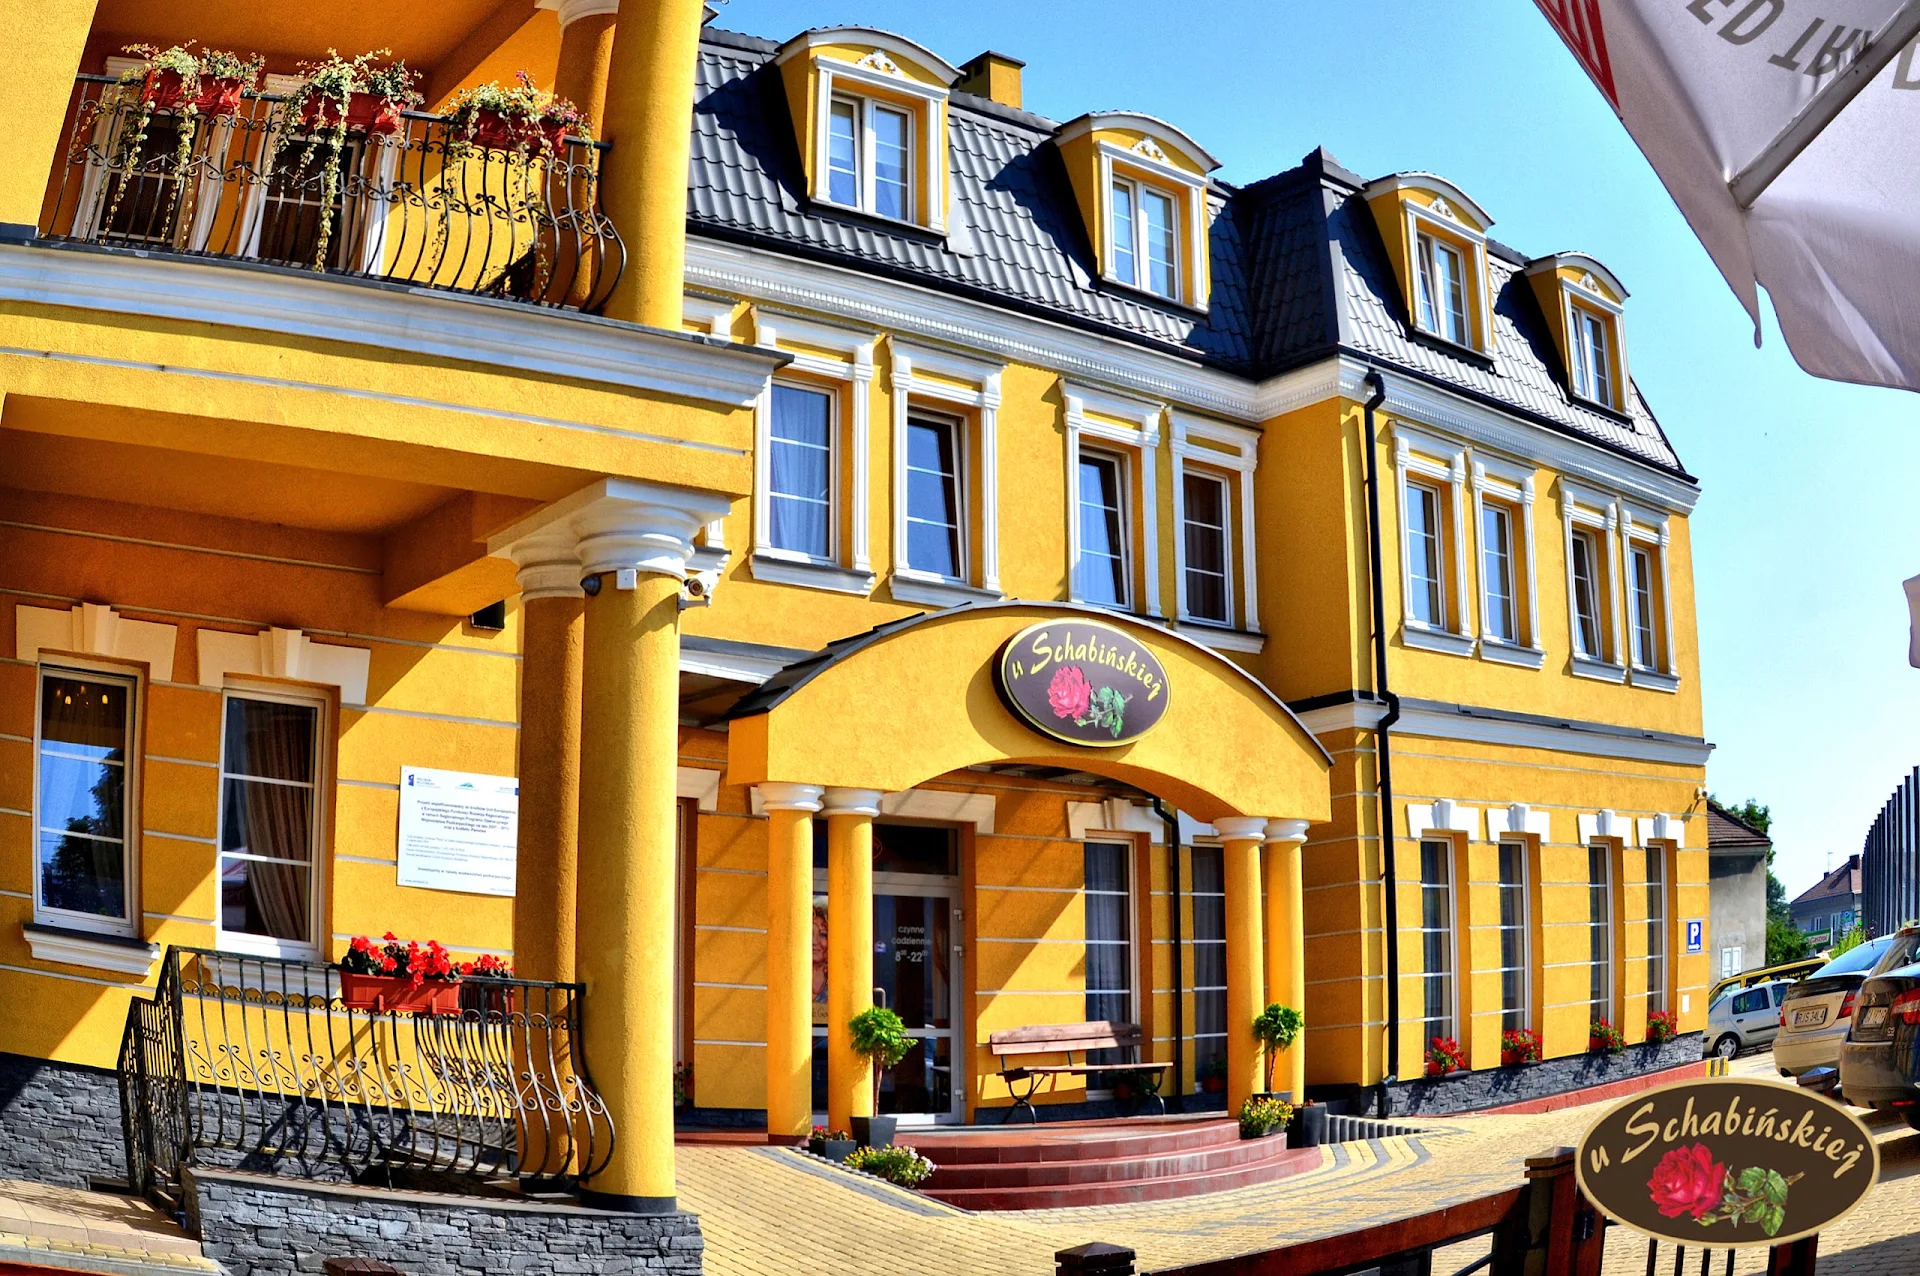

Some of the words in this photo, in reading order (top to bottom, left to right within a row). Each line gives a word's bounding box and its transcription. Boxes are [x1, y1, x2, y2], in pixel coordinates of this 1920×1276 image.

[1012, 660, 1024, 680] u
[1030, 631, 1163, 701] Schabińskiej
[898, 926, 925, 935] czynne
[1690, 923, 1700, 943] P
